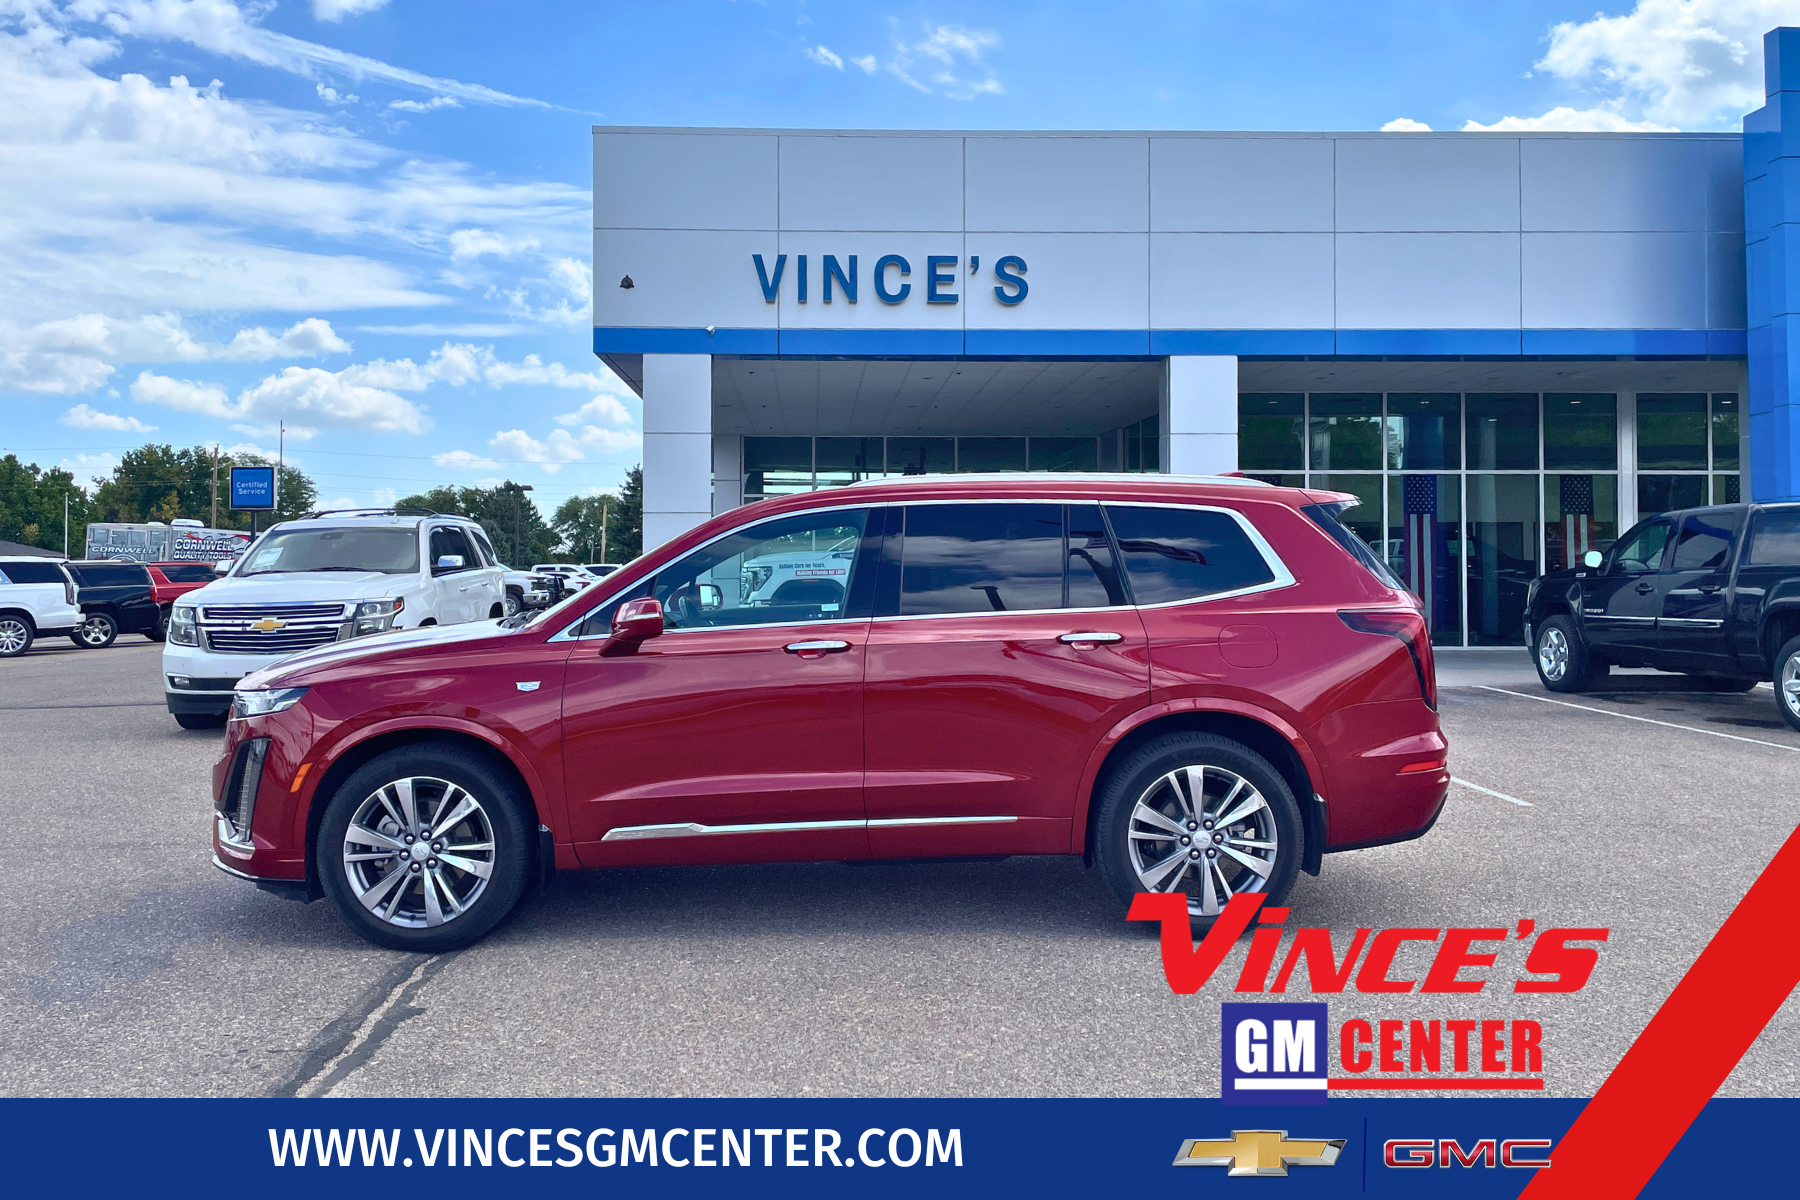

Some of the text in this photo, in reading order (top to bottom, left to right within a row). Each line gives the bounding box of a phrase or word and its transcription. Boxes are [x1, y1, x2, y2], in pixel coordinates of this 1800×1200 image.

[752, 254, 1029, 305] VINCE'S
[174, 538, 234, 550] CORNWELL
[92, 546, 154, 554] CORNWELL
[174, 551, 232, 560] QUALITY TOOLS
